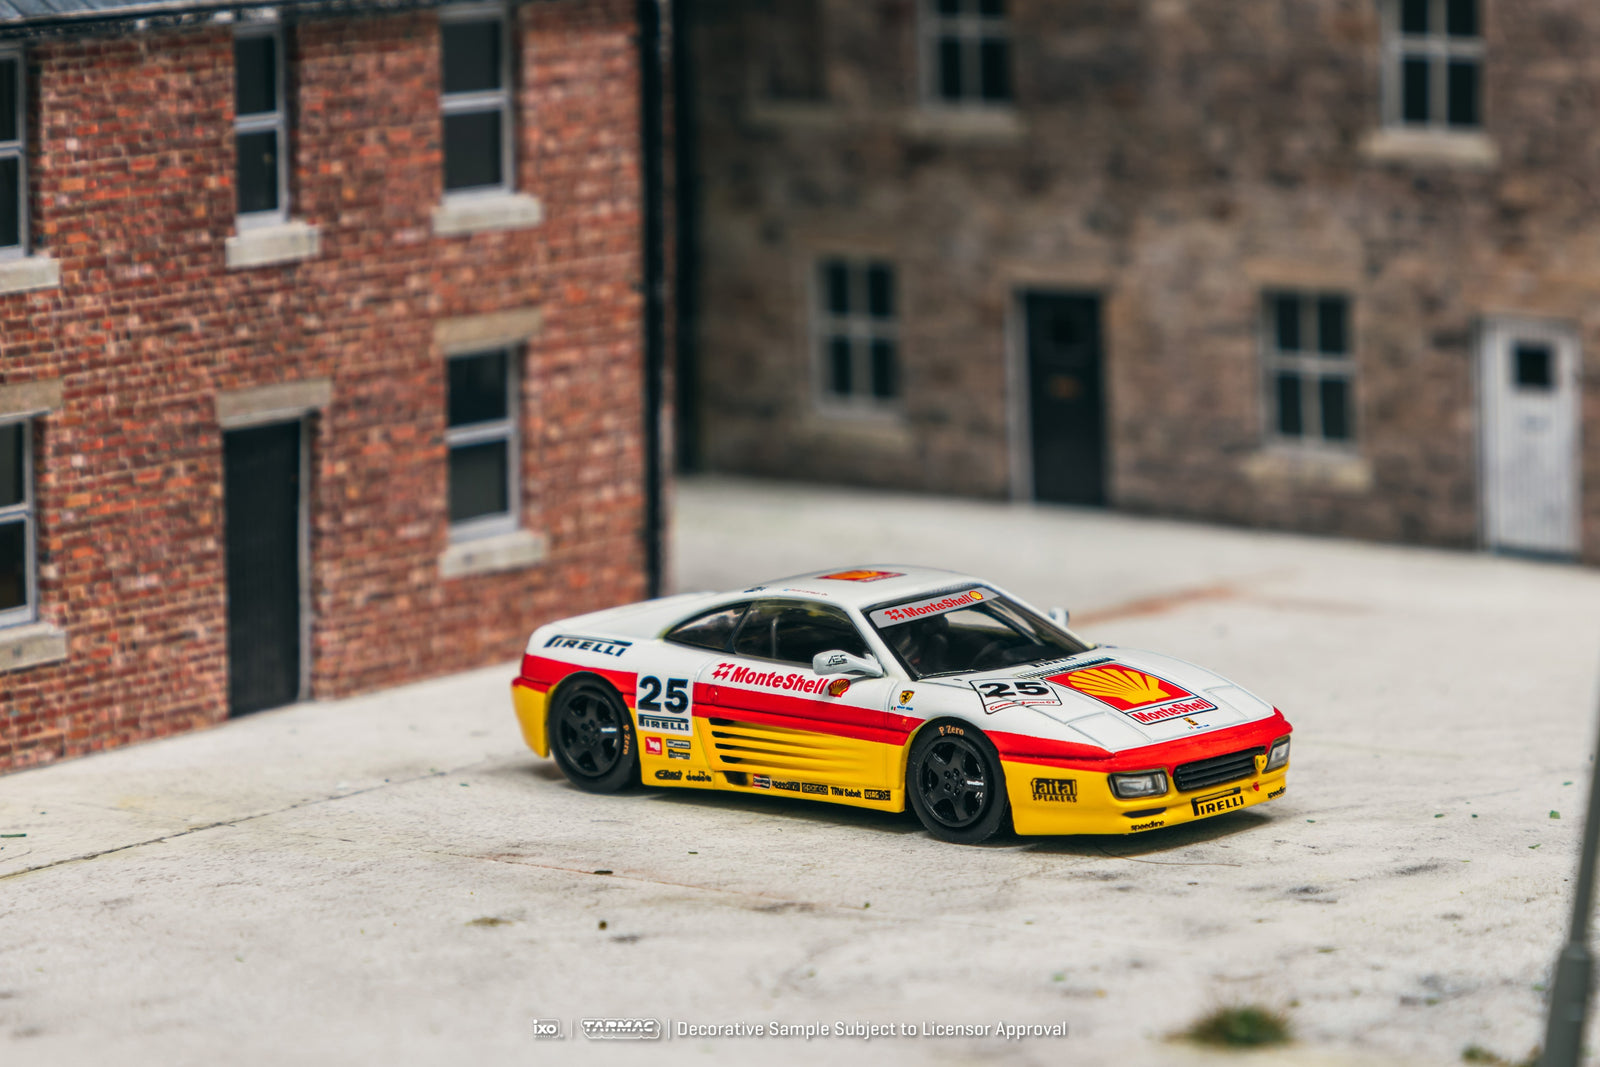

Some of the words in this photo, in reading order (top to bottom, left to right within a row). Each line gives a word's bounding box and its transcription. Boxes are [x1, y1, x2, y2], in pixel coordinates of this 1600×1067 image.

[904, 594, 973, 619] MonteShell
[544, 634, 633, 657] PIRELLI
[730, 666, 830, 695] MonteShell
[978, 681, 1050, 698] 25
[638, 675, 689, 714] 25
[638, 713, 690, 732] PIRELLI
[1131, 698, 1215, 724] MonteShell
[938, 725, 945, 737] P
[946, 724, 965, 736] Zero
[1031, 777, 1078, 797] faital
[1032, 794, 1078, 803] SPEAKERS
[1191, 786, 1245, 817] PIRELLI
